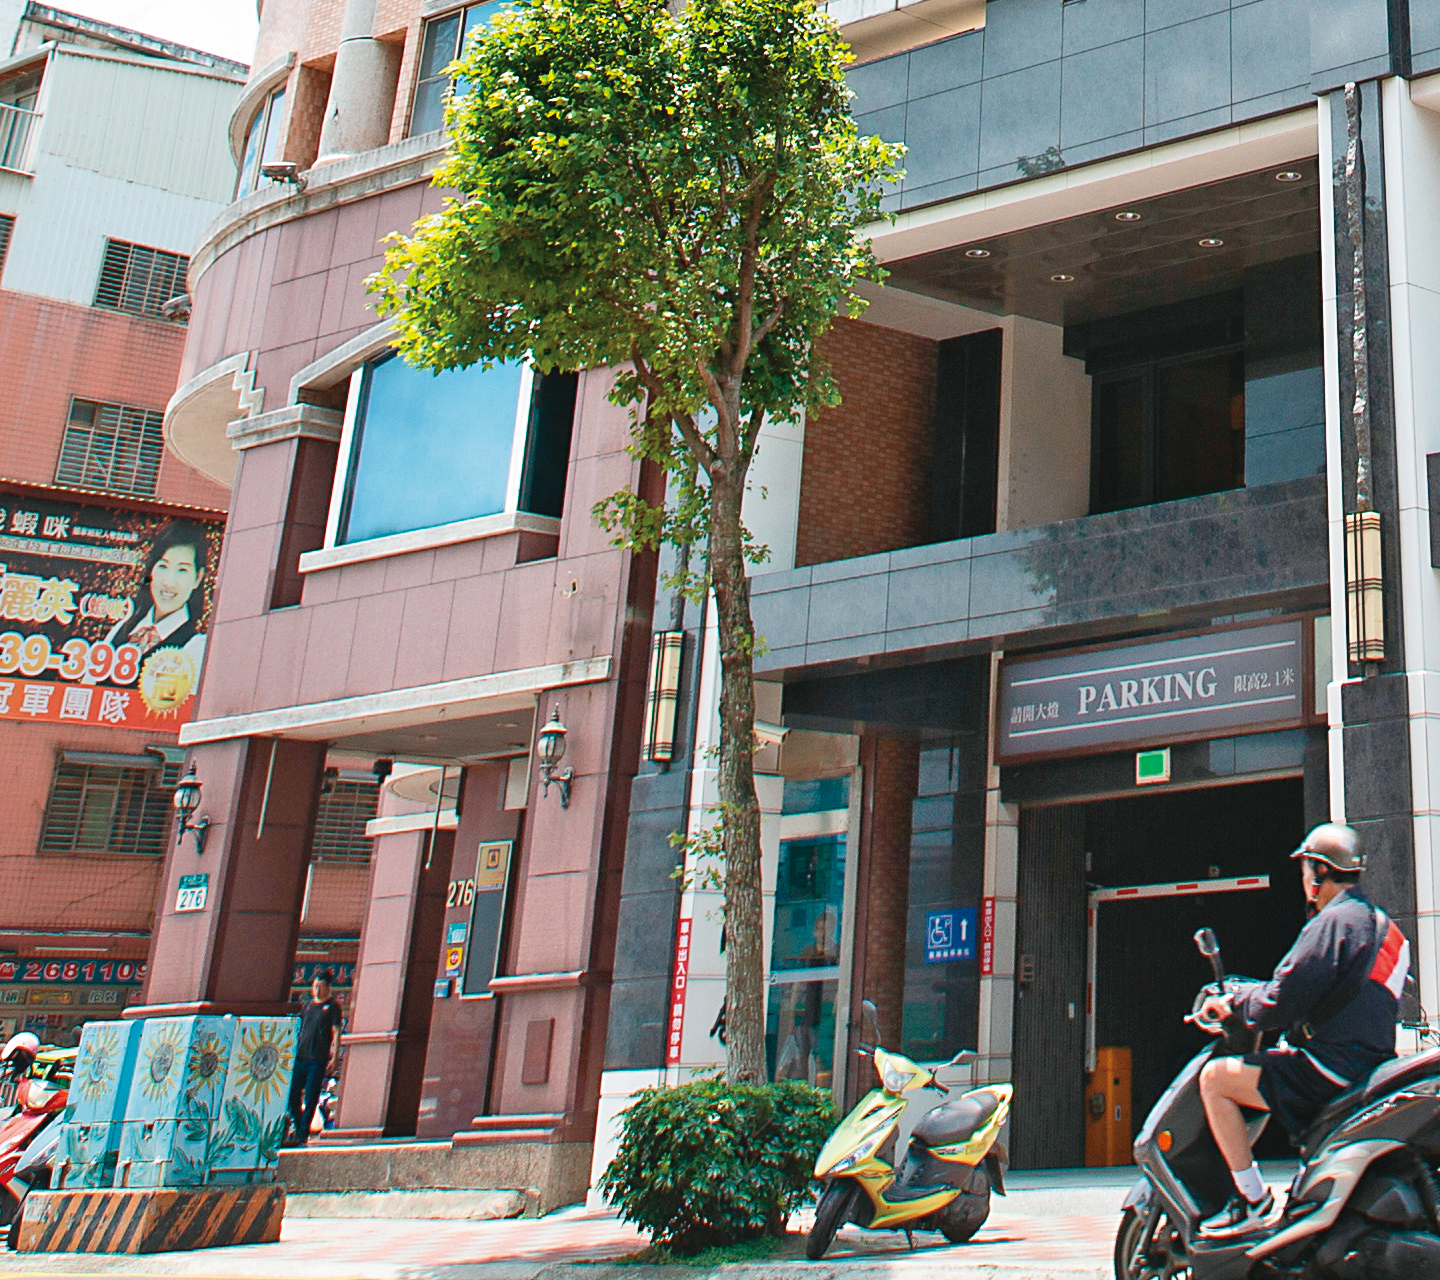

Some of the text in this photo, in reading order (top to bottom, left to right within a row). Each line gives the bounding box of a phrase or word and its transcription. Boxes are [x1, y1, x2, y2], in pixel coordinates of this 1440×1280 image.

[1077, 666, 1219, 717] PARKING
[1233, 667, 1297, 695] 限高2.1米
[1010, 700, 1060, 725] 請開大燈
[179, 889, 205, 908] 276
[445, 877, 475, 908] 276
